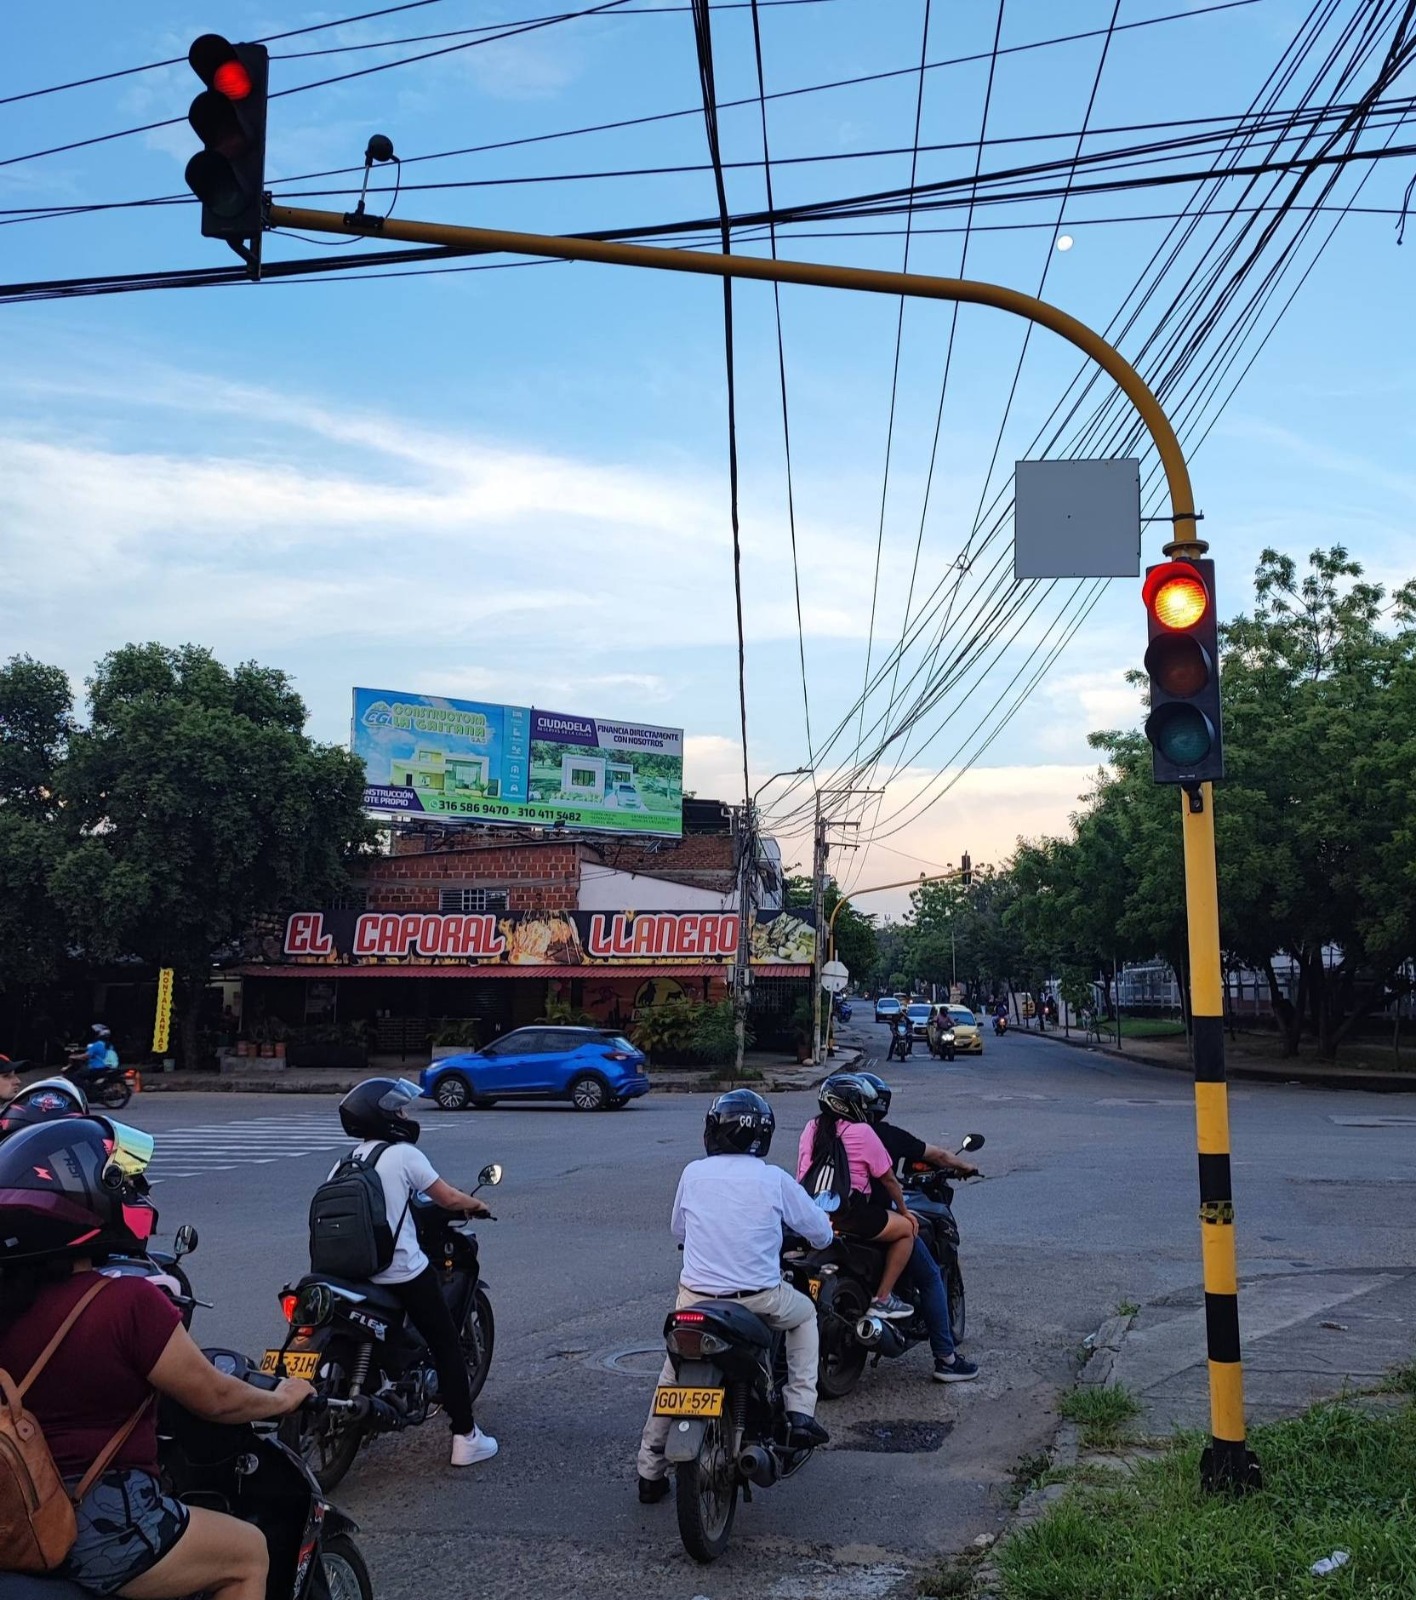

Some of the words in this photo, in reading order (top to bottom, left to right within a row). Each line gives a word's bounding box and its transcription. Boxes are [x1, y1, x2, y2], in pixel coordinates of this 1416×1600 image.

[393, 704, 486, 726] CONSTRUCTORA
[537, 717, 592, 733] CIUDADELA
[393, 716, 410, 728] LA
[415, 720, 485, 737] GAITANA
[597, 725, 628, 735] FINANCIA
[629, 729, 679, 741] DIRECTAMENTE
[614, 735, 628, 743] CON
[628, 737, 664, 747] NOSOTROS
[380, 797, 409, 806] PROPIO
[438, 800, 457, 811] 316
[460, 802, 480, 813] 586
[482, 804, 509, 816] 9470
[517, 807, 536, 818] 310
[538, 809, 554, 819] 411
[556, 810, 581, 821] 5482
[285, 913, 332, 954] EL
[353, 914, 505, 955] CAPORAL
[589, 914, 739, 955] LLANERO
[157, 970, 170, 1050] MONTALLANTAS
